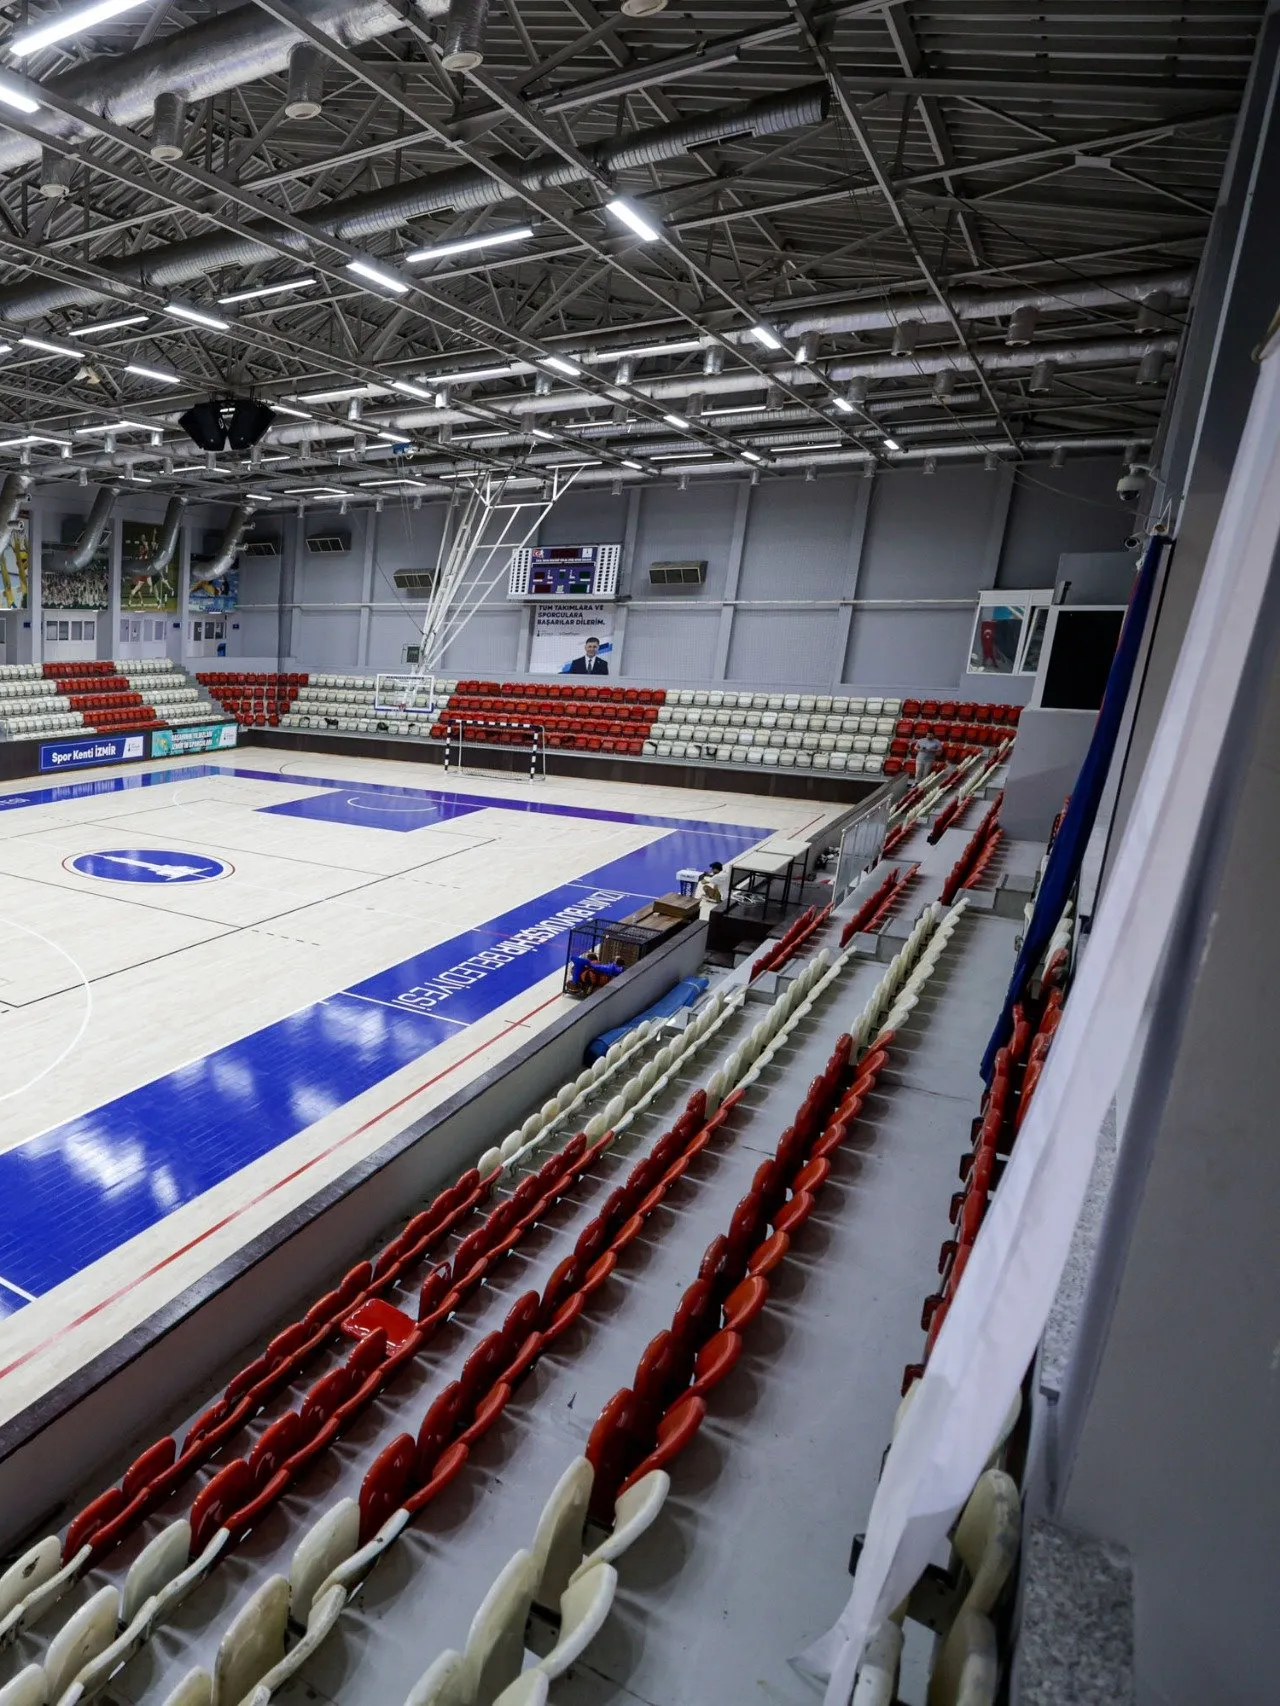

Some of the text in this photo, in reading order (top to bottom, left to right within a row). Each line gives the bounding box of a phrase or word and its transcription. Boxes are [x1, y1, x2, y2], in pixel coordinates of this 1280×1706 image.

[51, 752, 72, 764] Spor
[73, 747, 94, 760] Kenti
[95, 743, 116, 757] İZMİR
[392, 951, 516, 1011] BELEDİYESİ
